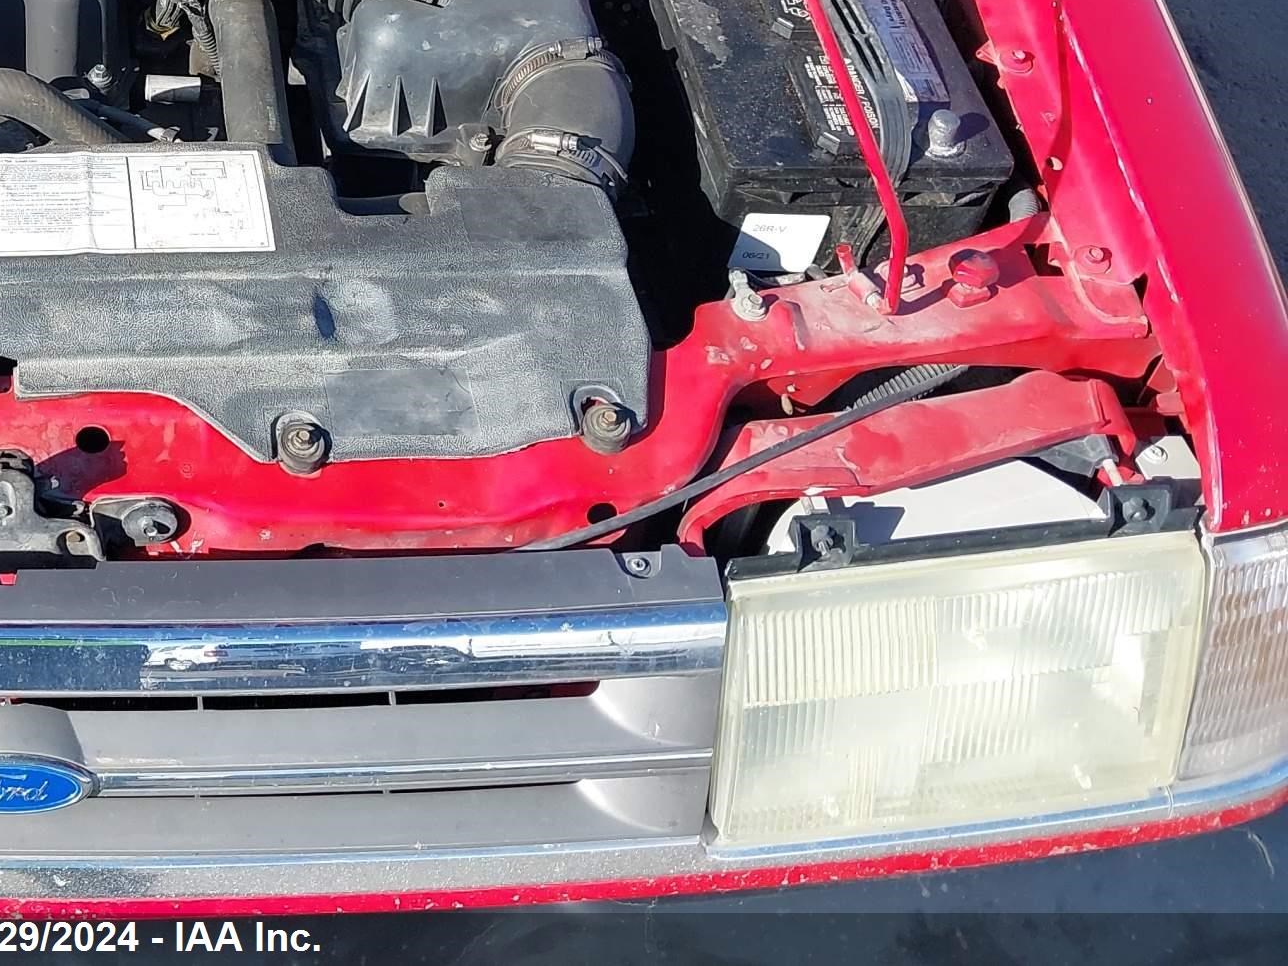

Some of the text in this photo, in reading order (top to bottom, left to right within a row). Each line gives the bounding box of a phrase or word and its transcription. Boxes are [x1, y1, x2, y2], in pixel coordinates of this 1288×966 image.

[883, 5, 895, 22] Days
[847, 65, 865, 94] DANGER
[862, 101, 881, 128] POISON
